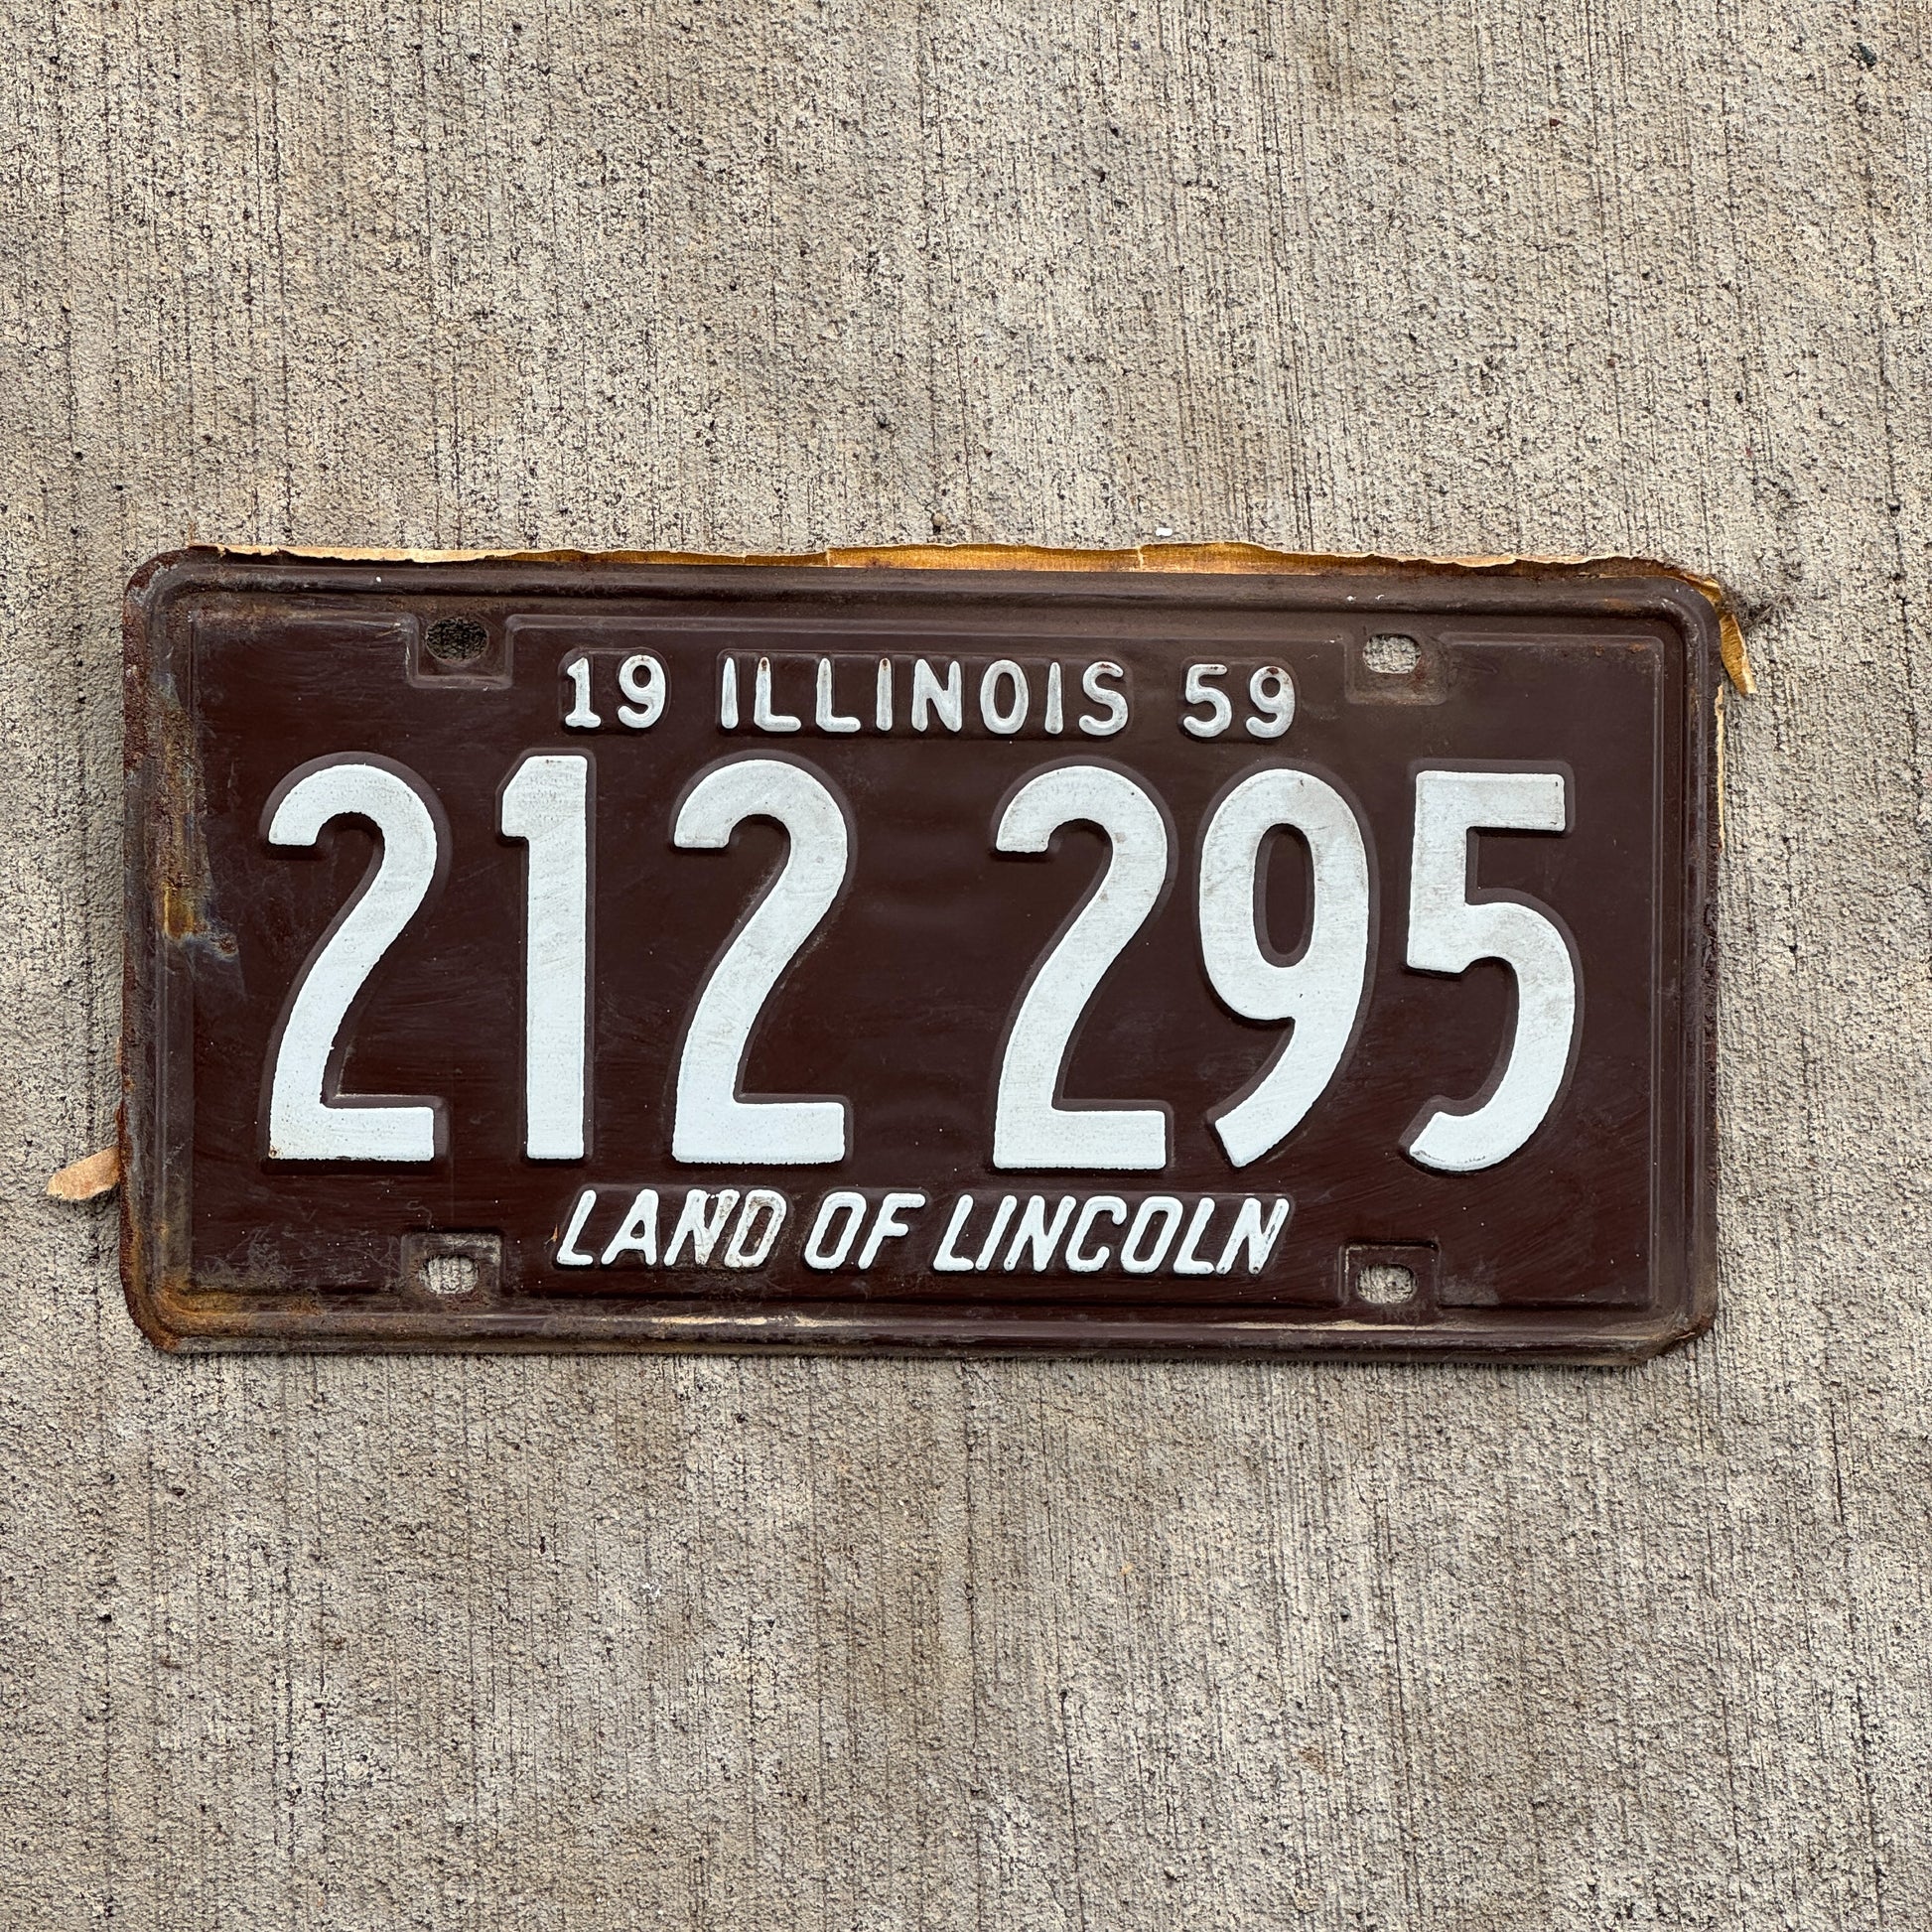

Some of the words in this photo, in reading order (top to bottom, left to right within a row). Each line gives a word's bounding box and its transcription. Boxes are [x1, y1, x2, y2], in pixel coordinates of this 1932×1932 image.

[564, 654, 667, 730] 19
[720, 656, 1130, 737] ILLINOIS
[1181, 662, 1297, 740] 59
[267, 755, 850, 1166] 212
[992, 763, 1577, 1173] 295
[555, 1187, 788, 1269] LAND
[803, 1191, 926, 1271] OF
[932, 1193, 1291, 1276] LINCOLN
